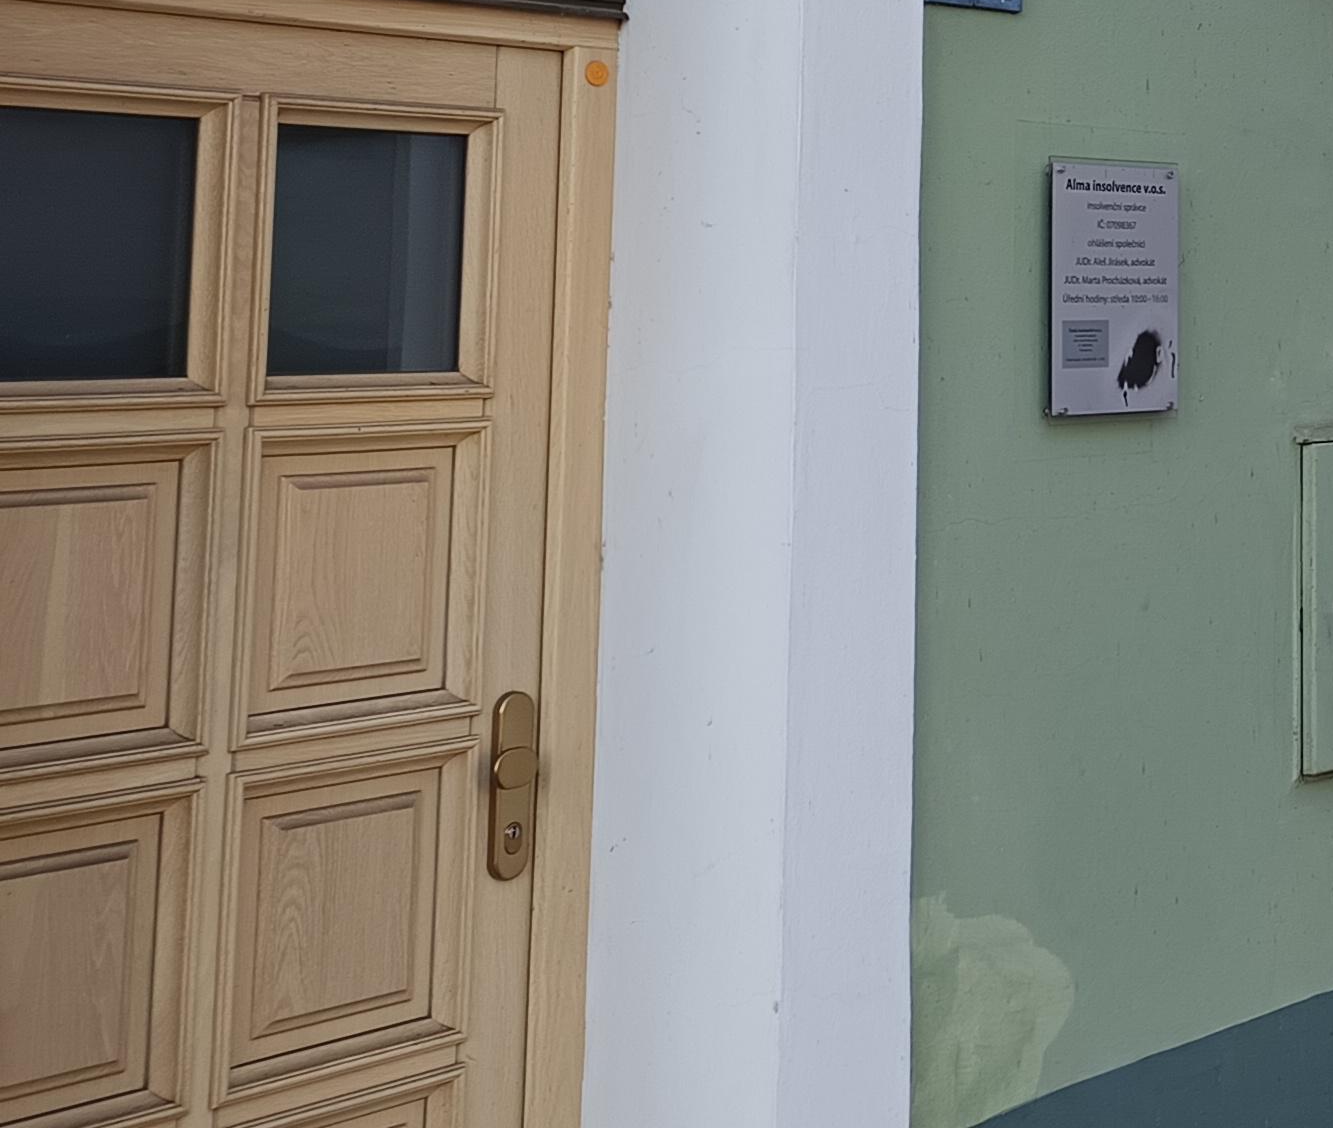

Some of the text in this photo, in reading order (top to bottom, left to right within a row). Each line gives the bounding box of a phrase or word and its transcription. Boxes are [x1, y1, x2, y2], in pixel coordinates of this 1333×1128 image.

[1065, 178, 1167, 194] Alma insolvence v.o.s.
